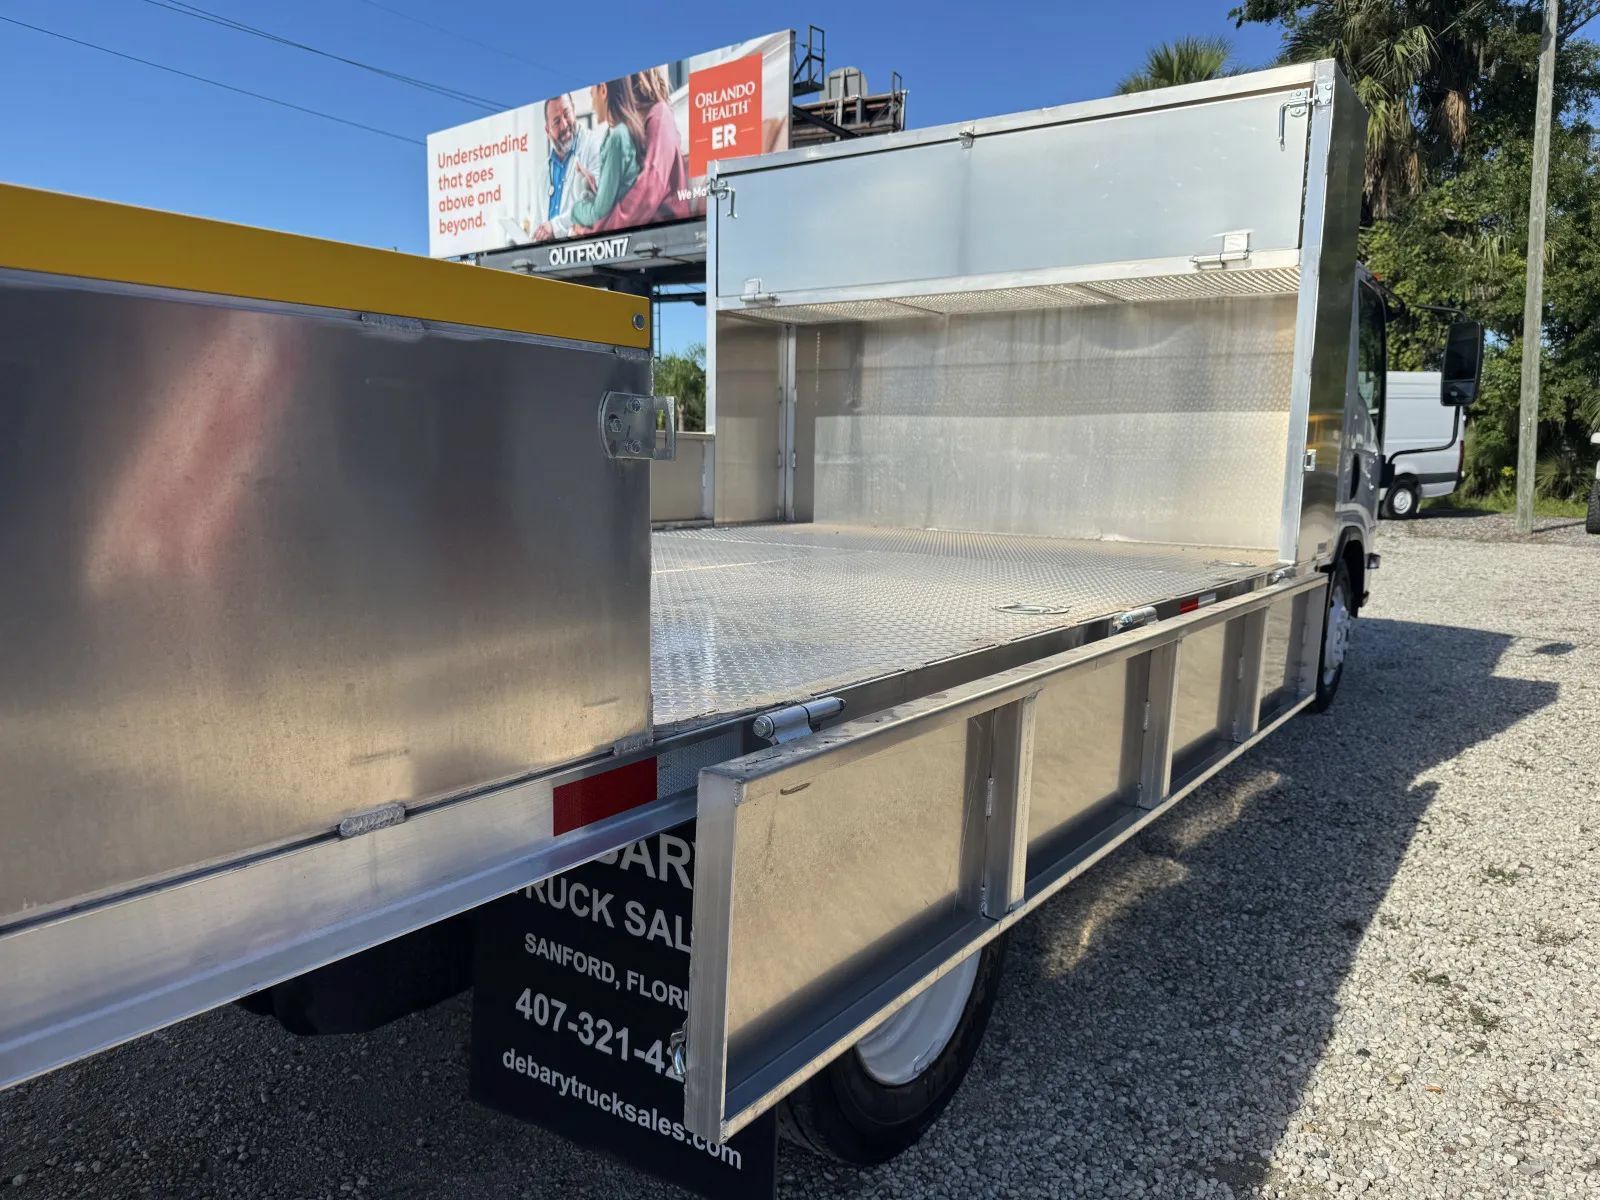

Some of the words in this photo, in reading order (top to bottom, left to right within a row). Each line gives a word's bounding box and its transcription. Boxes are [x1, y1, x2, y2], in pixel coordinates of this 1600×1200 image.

[695, 81, 756, 109] ORLANDO
[702, 99, 752, 124] HEALTH
[437, 133, 528, 169] Understanding
[711, 123, 737, 151] ER
[438, 174, 463, 191] that
[465, 167, 494, 188] goes
[438, 195, 475, 213] above
[477, 184, 502, 205] and
[677, 188, 692, 201] We
[439, 211, 486, 236] beyond.
[624, 900, 693, 954] SAL
[524, 932, 622, 991] SANFORD,
[626, 969, 689, 1012] FLORI
[502, 1048, 742, 1170] debarytrucksales.com
